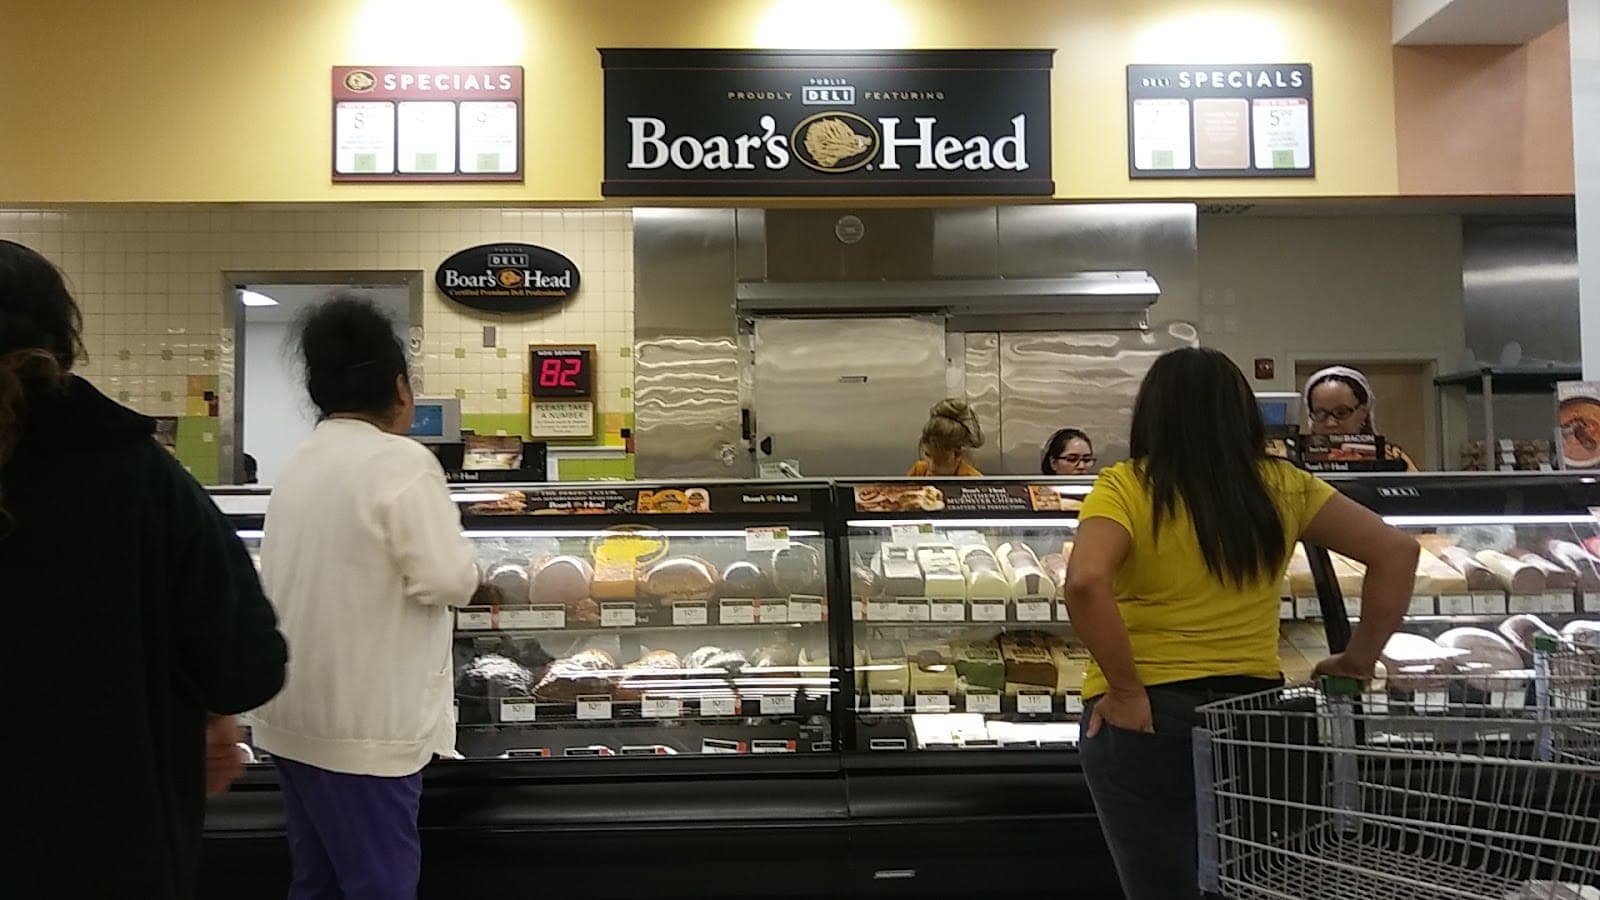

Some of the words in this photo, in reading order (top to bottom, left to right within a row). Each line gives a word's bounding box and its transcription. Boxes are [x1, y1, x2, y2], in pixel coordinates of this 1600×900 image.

[384, 74, 512, 91] SPECIALS
[1178, 71, 1303, 88] SPECIALS
[728, 91, 793, 100] PROUDLY
[808, 90, 849, 100] DELI
[865, 91, 944, 100] FEATURING
[627, 114, 790, 170] Boar's
[877, 113, 1029, 171] Head
[492, 255, 525, 265] DELI
[445, 269, 497, 287] Boar's
[523, 270, 571, 288] Head
[540, 358, 581, 386] 82
